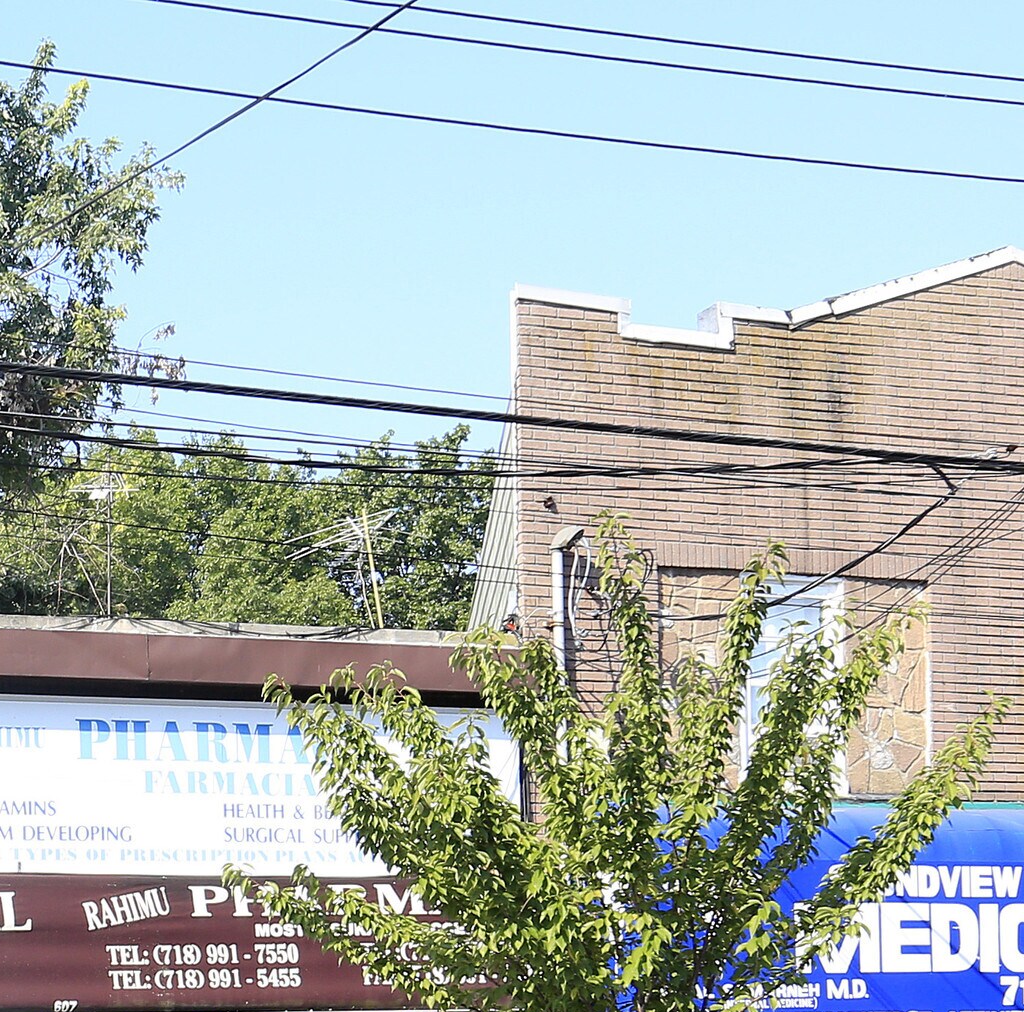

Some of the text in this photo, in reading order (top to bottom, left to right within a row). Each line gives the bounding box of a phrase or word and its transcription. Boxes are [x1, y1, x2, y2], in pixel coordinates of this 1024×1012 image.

[75, 718, 326, 765] PHARMA
[143, 769, 318, 798] FARMACIA
[222, 803, 285, 820] HEALTH
[293, 806, 305, 820] &
[22, 824, 132, 842] DEVELOPING
[224, 826, 360, 844] SURGICAL SUPP
[13, 847, 78, 862] TYPES
[86, 848, 110, 862] OF
[120, 848, 270, 864] PRESCRIPTION
[276, 849, 337, 863] PLANS
[82, 885, 171, 932] RAHIMU
[106, 944, 150, 966] TEL:
[152, 943, 202, 966] (718)
[206, 943, 239, 965] 991
[254, 942, 299, 965] 7550
[108, 969, 152, 990] TEL:
[154, 968, 205, 990] (718)
[208, 968, 242, 989] 991
[256, 967, 302, 989] 5455
[827, 979, 870, 999] M.D.
[53, 1000, 79, 1012] 607
